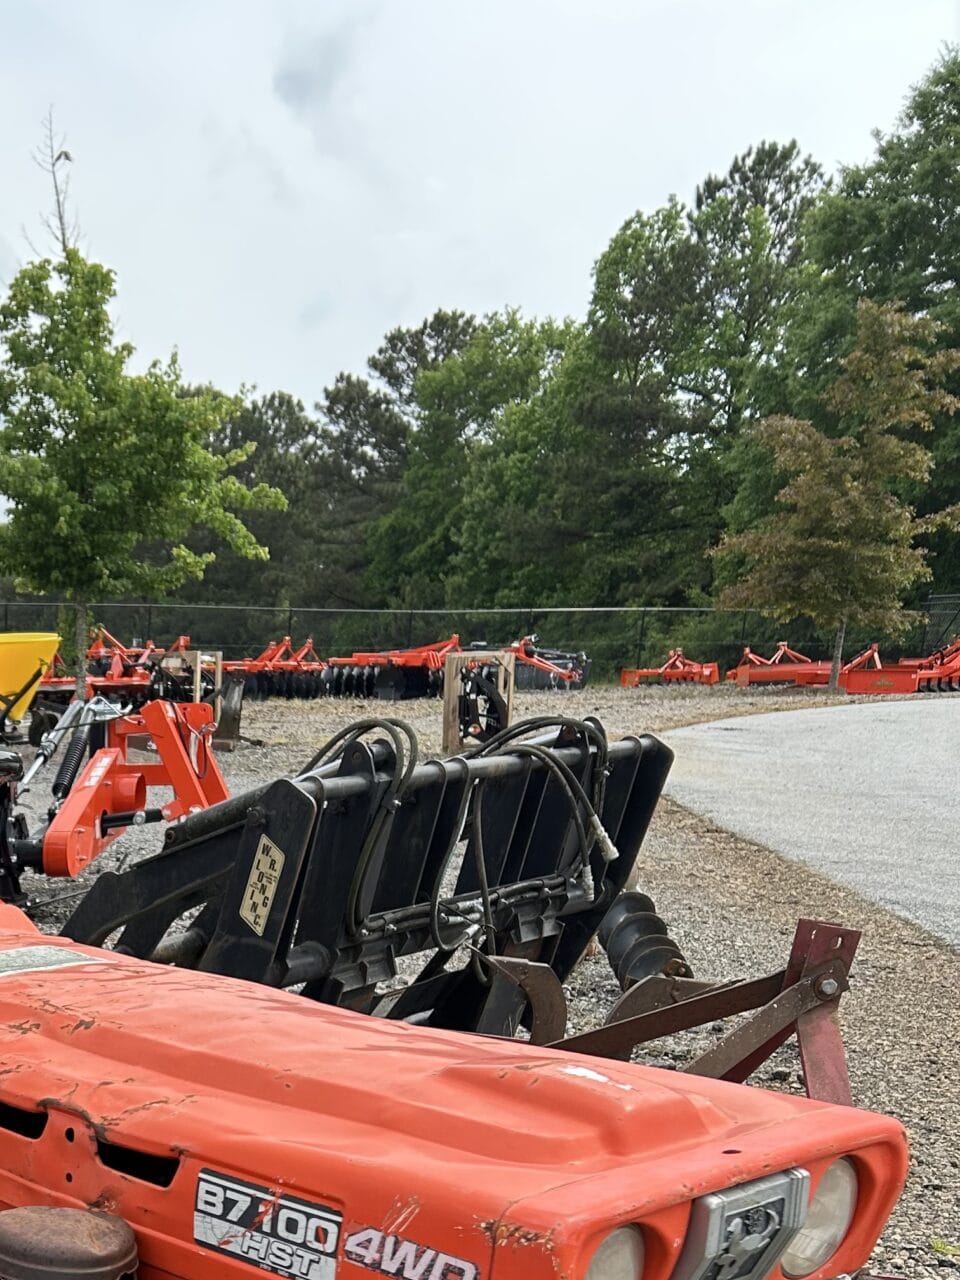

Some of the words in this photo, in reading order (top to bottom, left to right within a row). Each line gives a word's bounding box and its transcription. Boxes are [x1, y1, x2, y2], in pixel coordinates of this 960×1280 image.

[256, 859, 270, 908] LONG
[196, 1180, 339, 1254] B7100
[241, 1232, 321, 1277] HST
